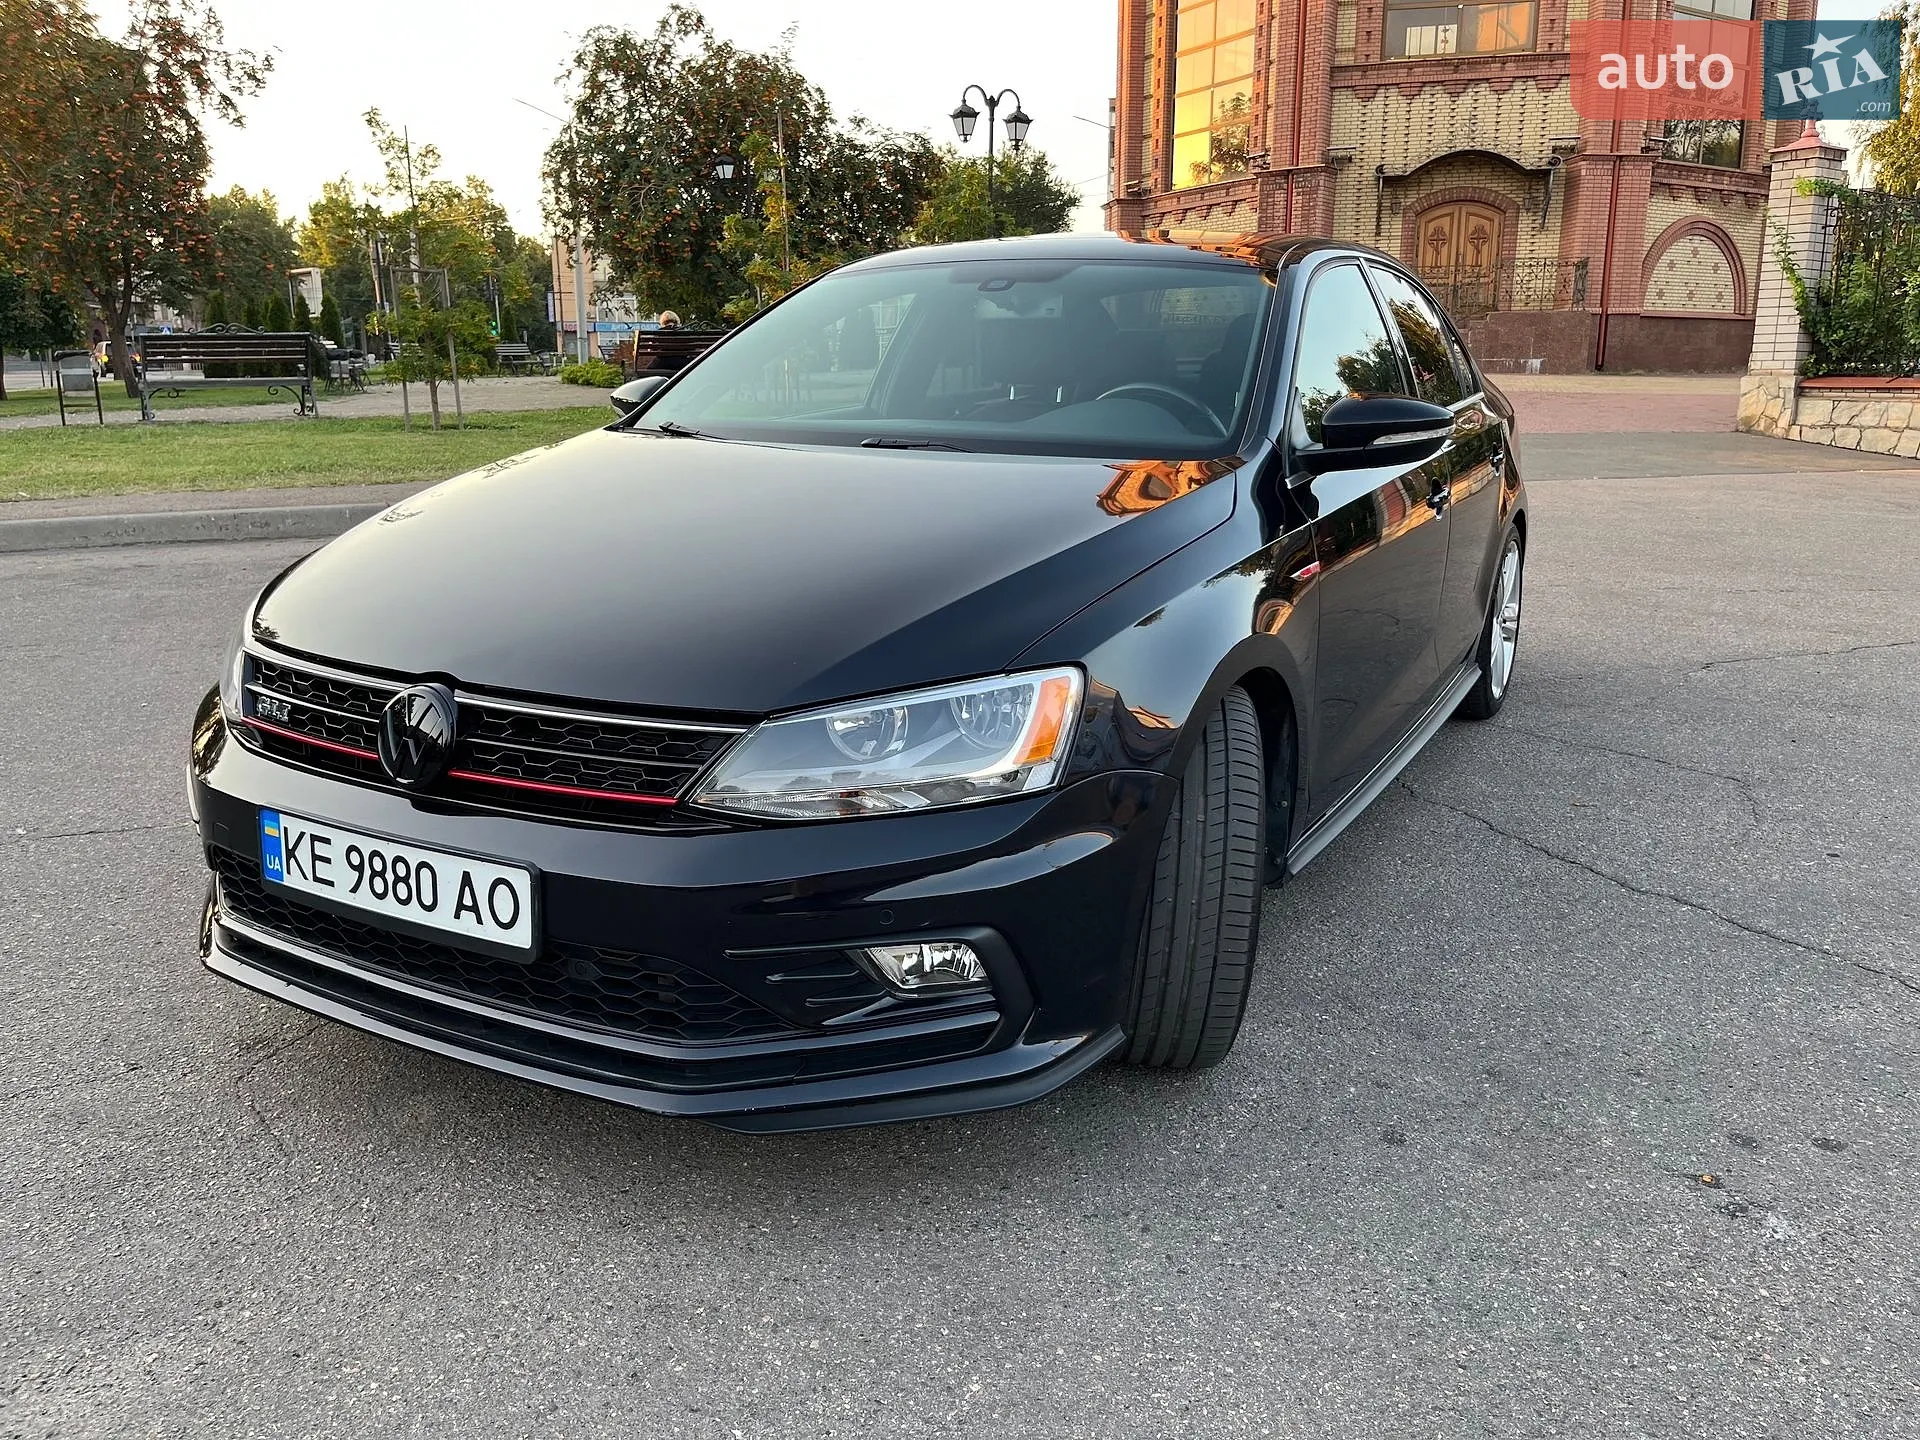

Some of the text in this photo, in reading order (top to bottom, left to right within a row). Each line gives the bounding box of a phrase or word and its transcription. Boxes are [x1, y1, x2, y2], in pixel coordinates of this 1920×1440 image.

[266, 853, 282, 872] UA
[283, 826, 520, 931] KE 9880 AO
